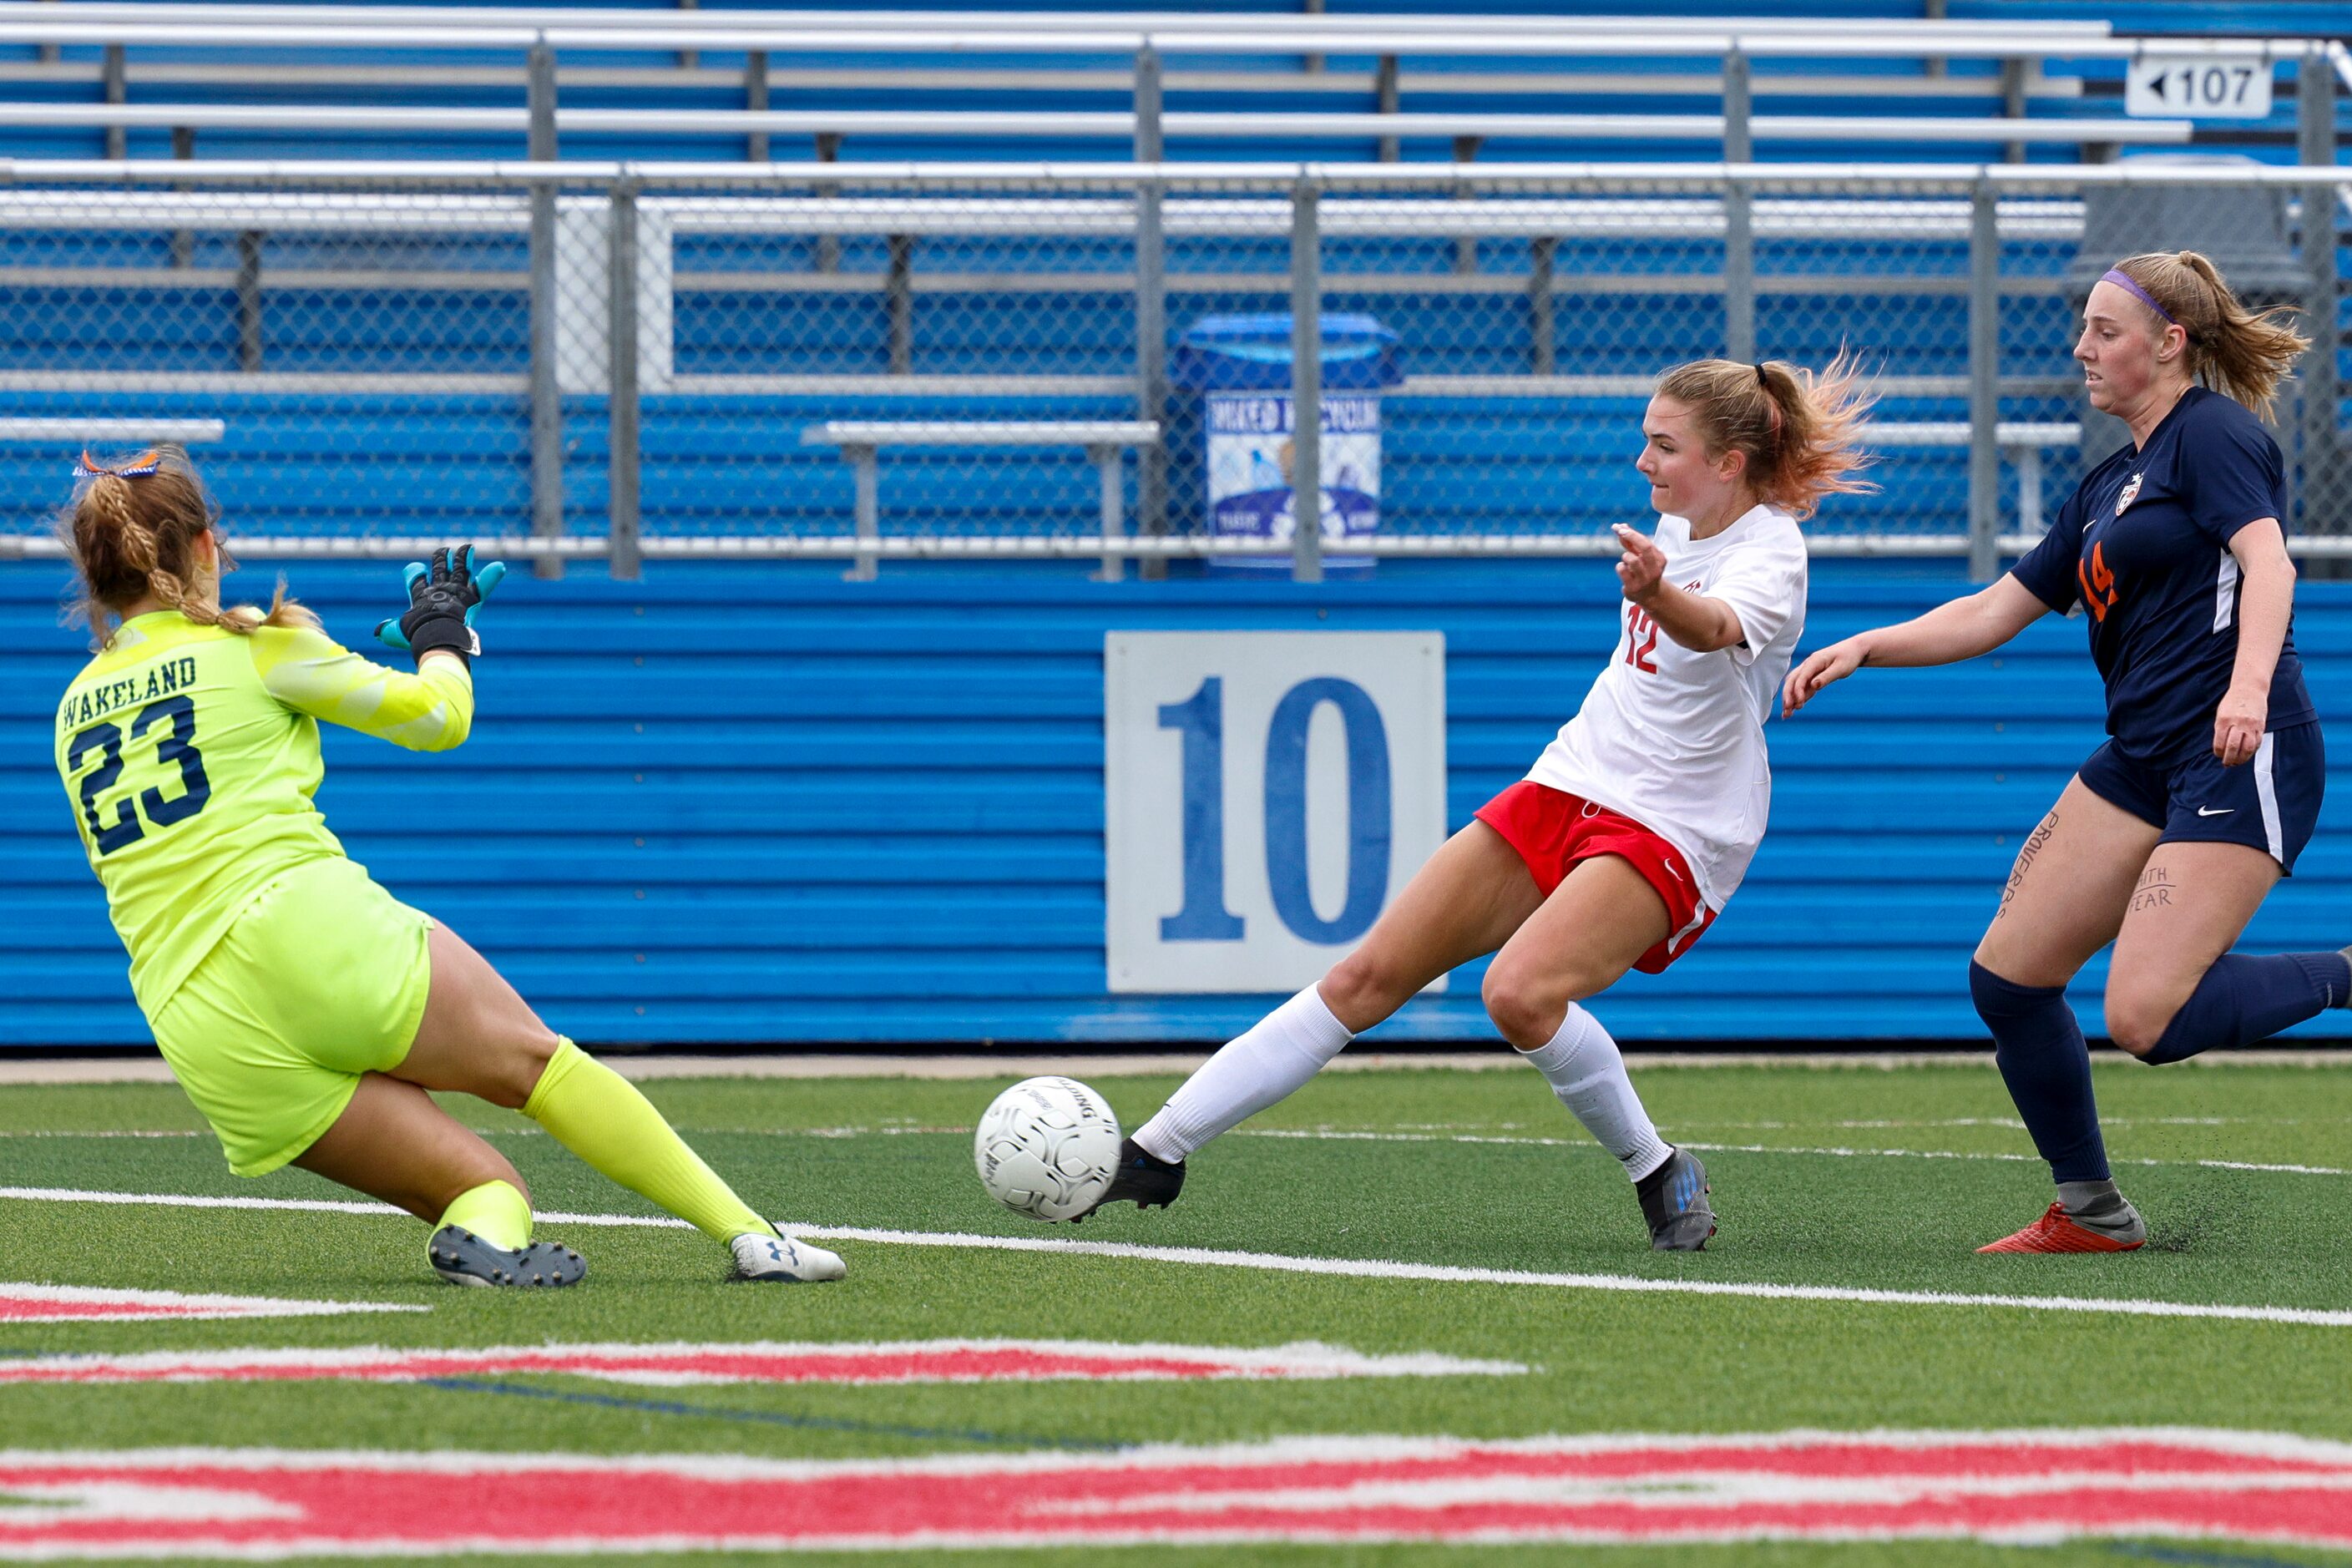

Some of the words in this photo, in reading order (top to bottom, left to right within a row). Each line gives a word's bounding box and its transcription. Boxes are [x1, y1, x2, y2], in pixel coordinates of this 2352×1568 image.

[2181, 68, 2253, 104] 107
[2079, 541, 2119, 623] 14
[1626, 602, 1660, 675] 12
[63, 656, 196, 731] WAKELAND
[68, 694, 211, 857] 23
[1157, 676, 1393, 946] 10
